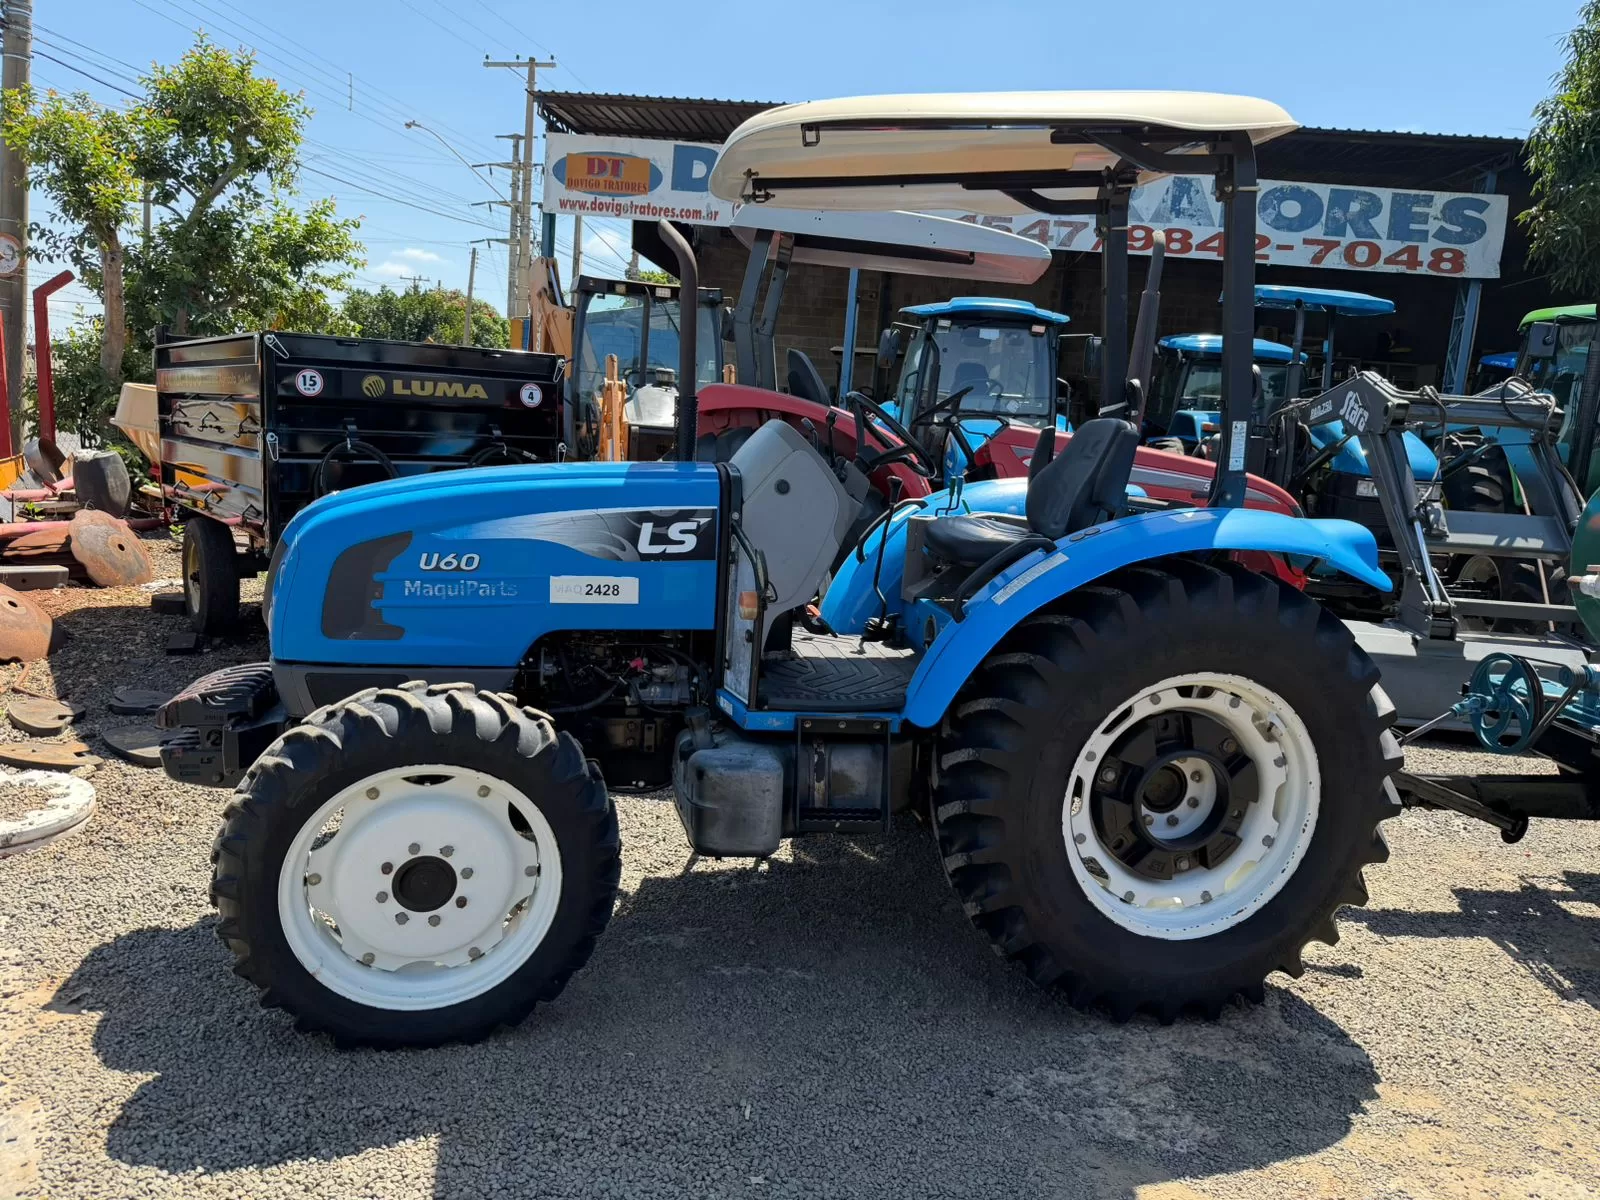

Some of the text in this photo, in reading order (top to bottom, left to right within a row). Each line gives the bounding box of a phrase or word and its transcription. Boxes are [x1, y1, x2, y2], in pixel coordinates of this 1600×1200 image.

[587, 157, 625, 179] DT
[567, 177, 648, 193] DOVIGO TRATORES
[1128, 175, 1492, 245] AORES
[301, 374, 318, 387] 15
[392, 379, 489, 399] LUMA
[528, 391, 534, 401] 4
[1339, 391, 1369, 432] Stara
[637, 518, 706, 553] LS
[419, 553, 480, 571] U60
[404, 580, 518, 599] MaquiParts
[585, 583, 620, 596] 2428
